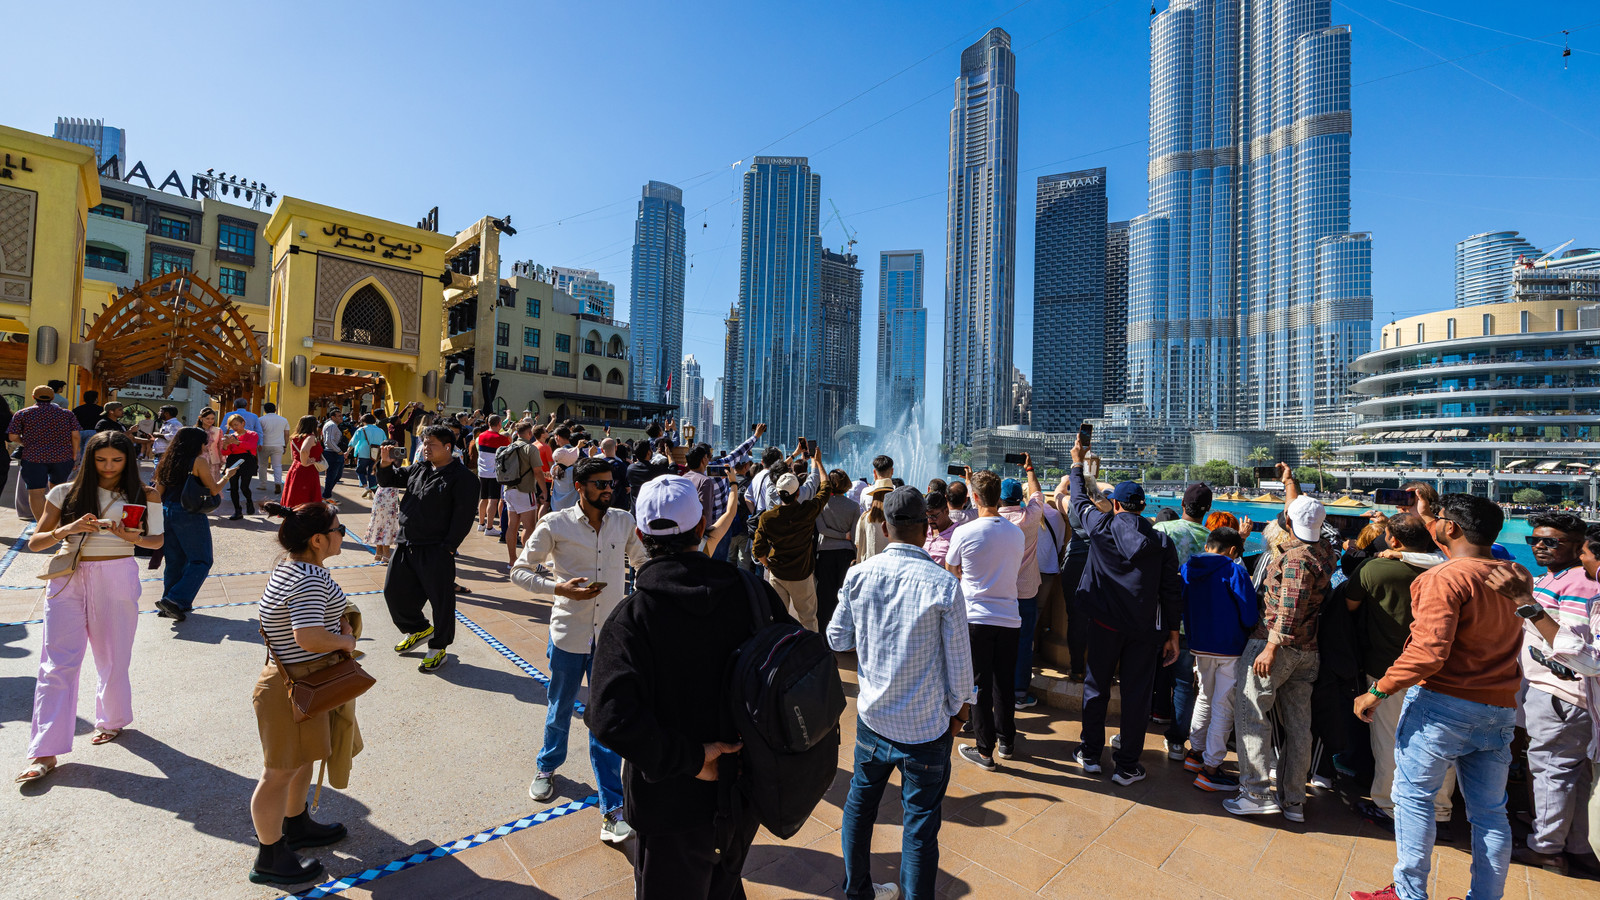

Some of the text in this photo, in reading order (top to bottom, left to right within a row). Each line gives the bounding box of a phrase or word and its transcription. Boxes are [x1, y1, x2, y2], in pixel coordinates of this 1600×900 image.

[1060, 176, 1099, 189] EMAAR
[322, 223, 423, 255] دبي مول
[794, 706, 809, 745] GEAR
